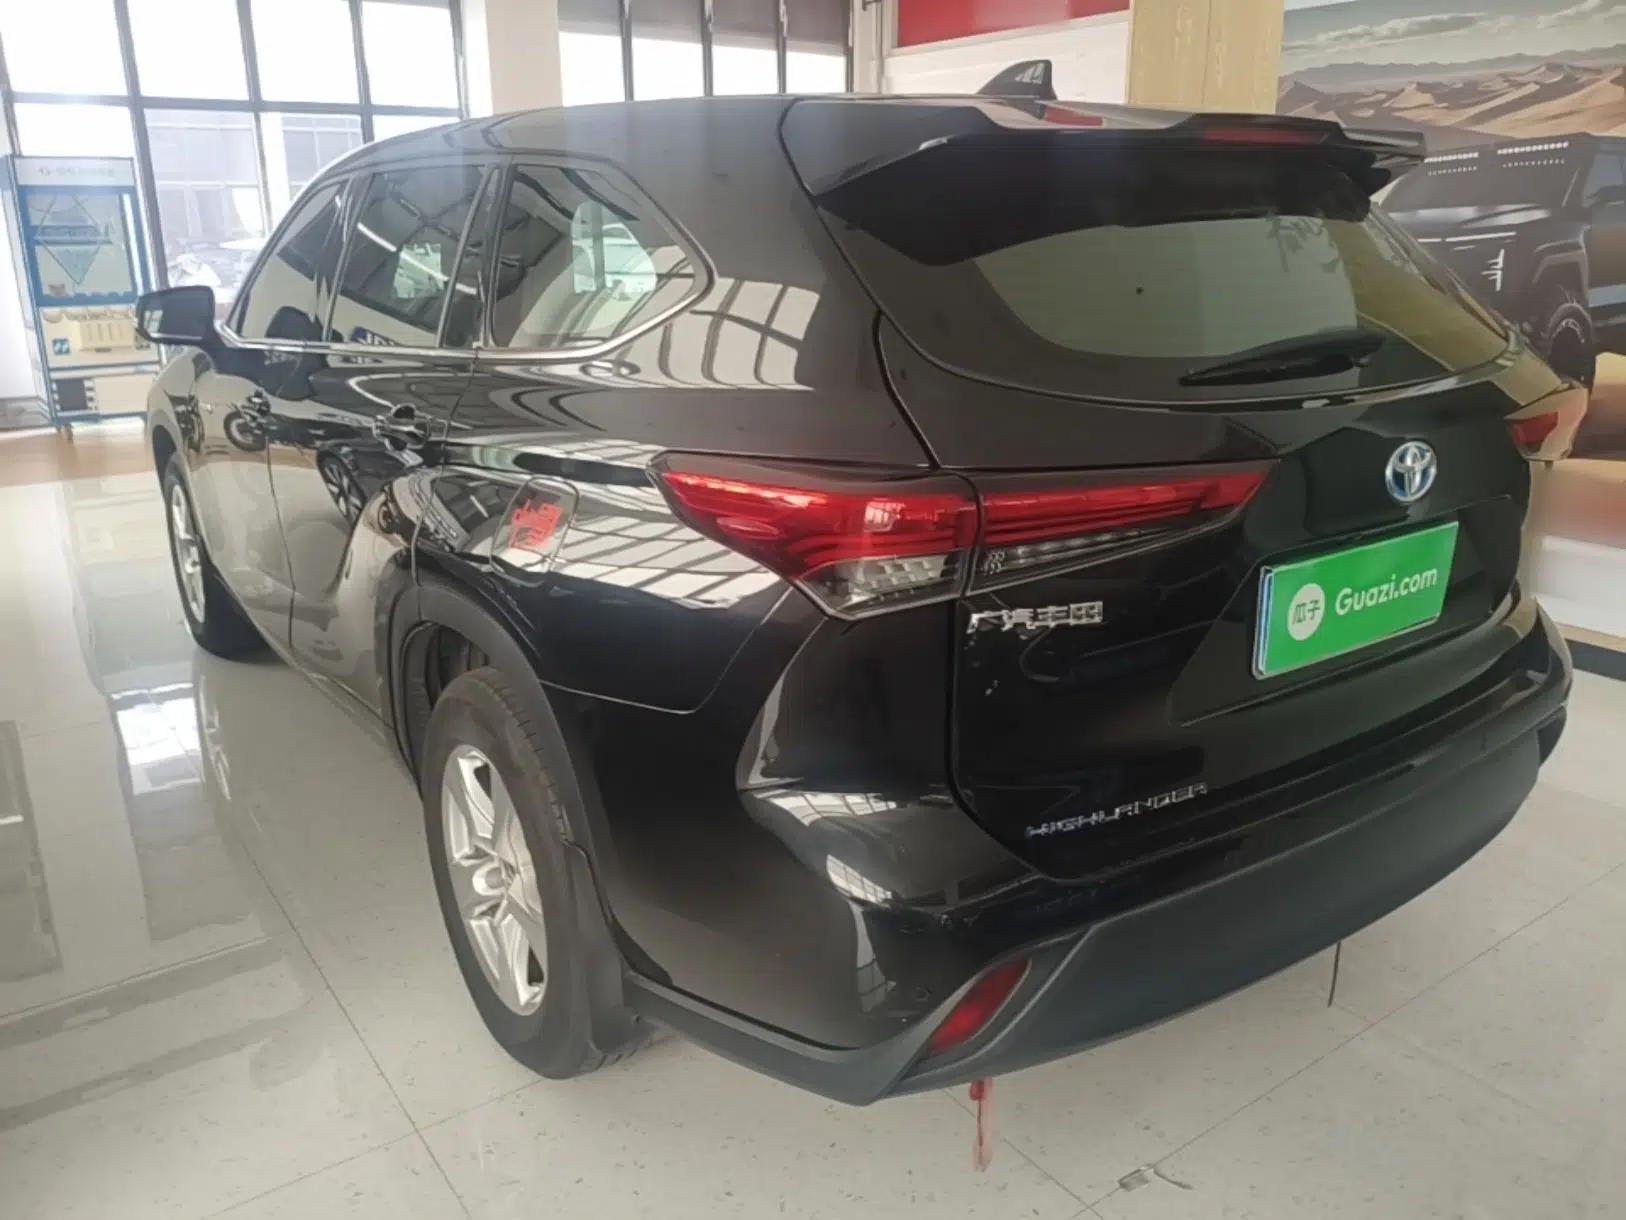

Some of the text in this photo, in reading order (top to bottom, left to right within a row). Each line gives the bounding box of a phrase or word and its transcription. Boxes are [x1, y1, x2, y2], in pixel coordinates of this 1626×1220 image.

[1291, 599, 1321, 625] 瓜子
[1335, 568, 1437, 616] Guazi.com
[966, 601, 1104, 635] 广汽丰田
[1025, 783, 1207, 837] HIGHLANDER
